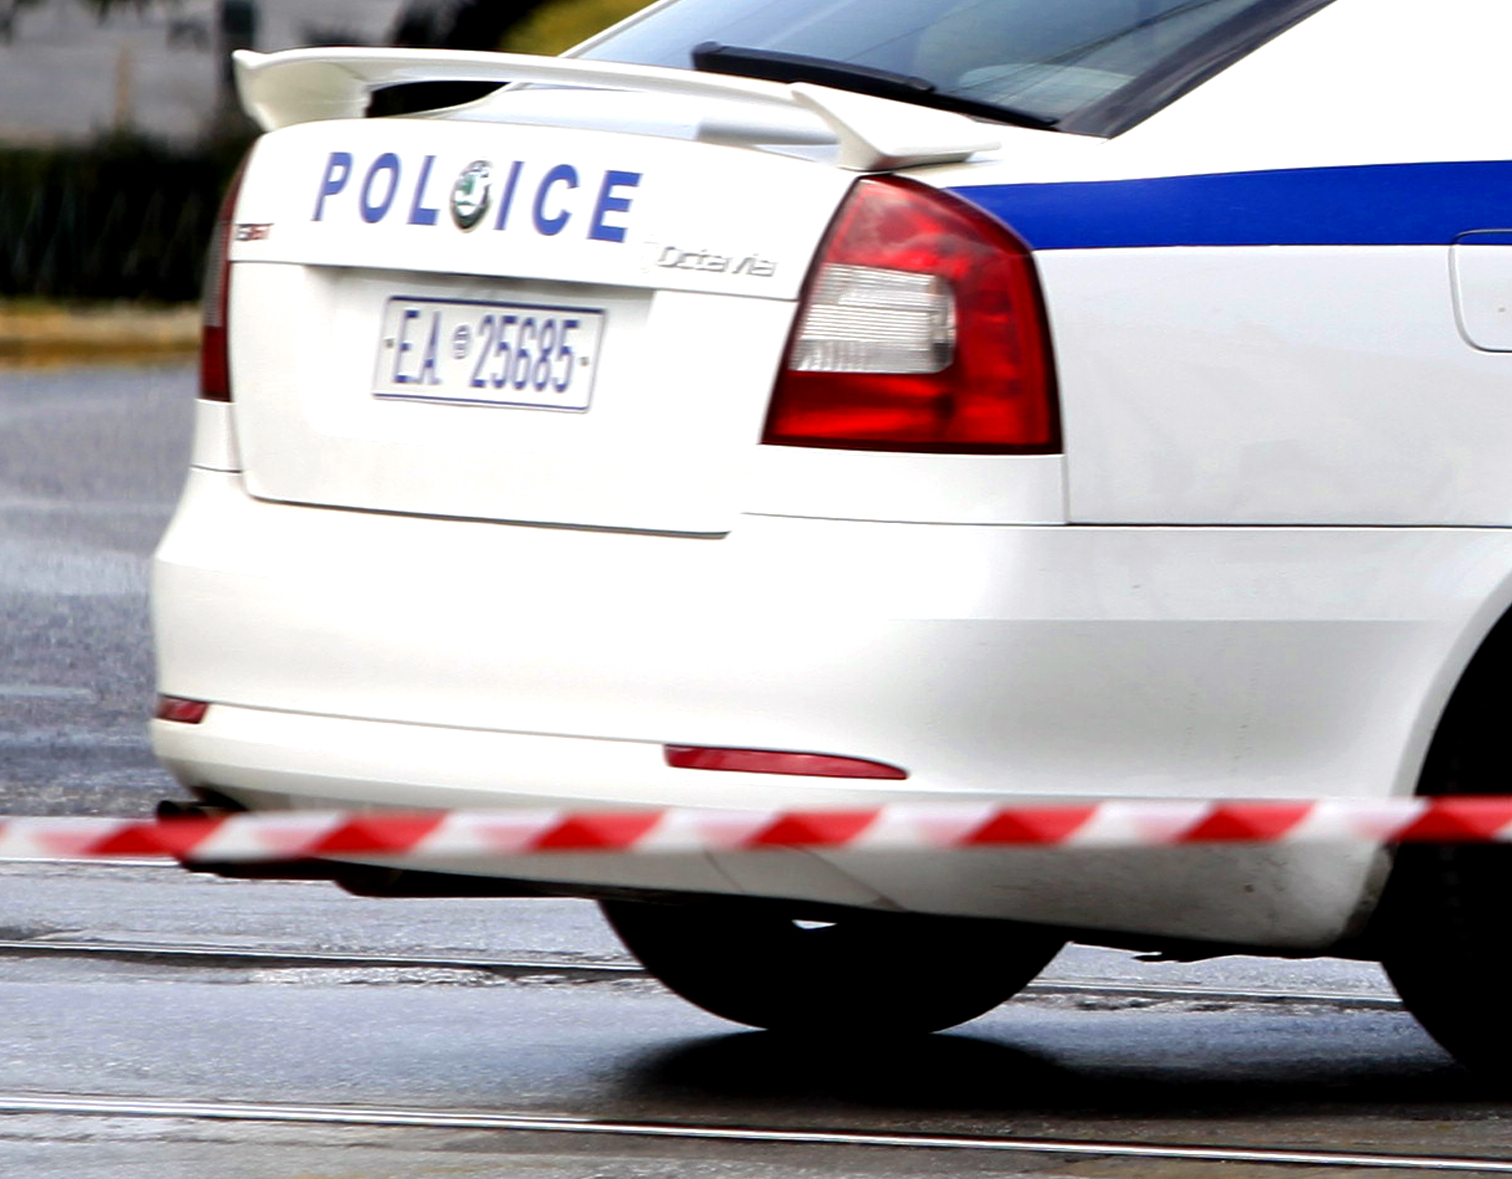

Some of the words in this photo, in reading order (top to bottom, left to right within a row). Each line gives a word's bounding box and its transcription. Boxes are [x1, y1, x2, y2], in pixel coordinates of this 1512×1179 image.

[311, 151, 644, 243] POLICE
[656, 246, 779, 277] Octavia
[468, 314, 580, 393] 25685
